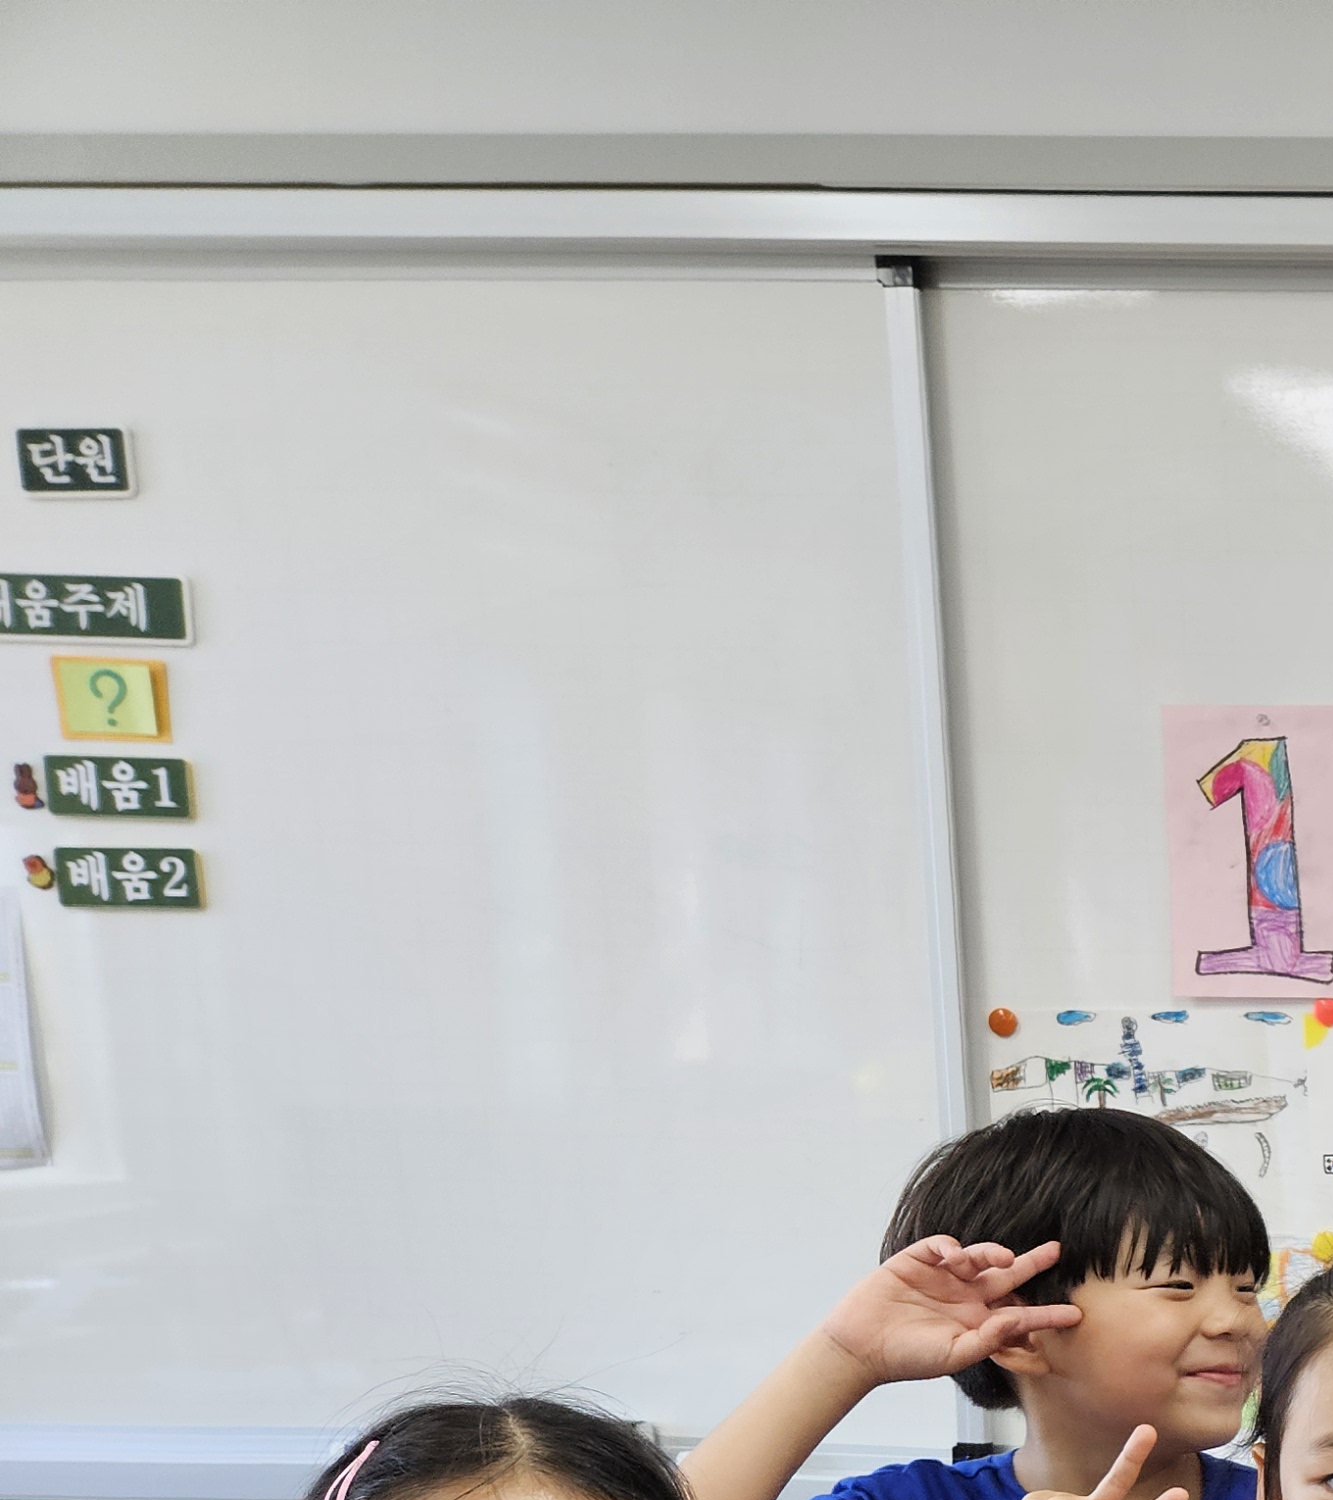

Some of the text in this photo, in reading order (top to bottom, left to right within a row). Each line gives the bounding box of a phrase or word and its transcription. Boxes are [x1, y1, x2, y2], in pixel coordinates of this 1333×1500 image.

[27, 434, 118, 484] 단원
[55, 759, 179, 813] 배움1
[68, 851, 189, 902] 배움2
